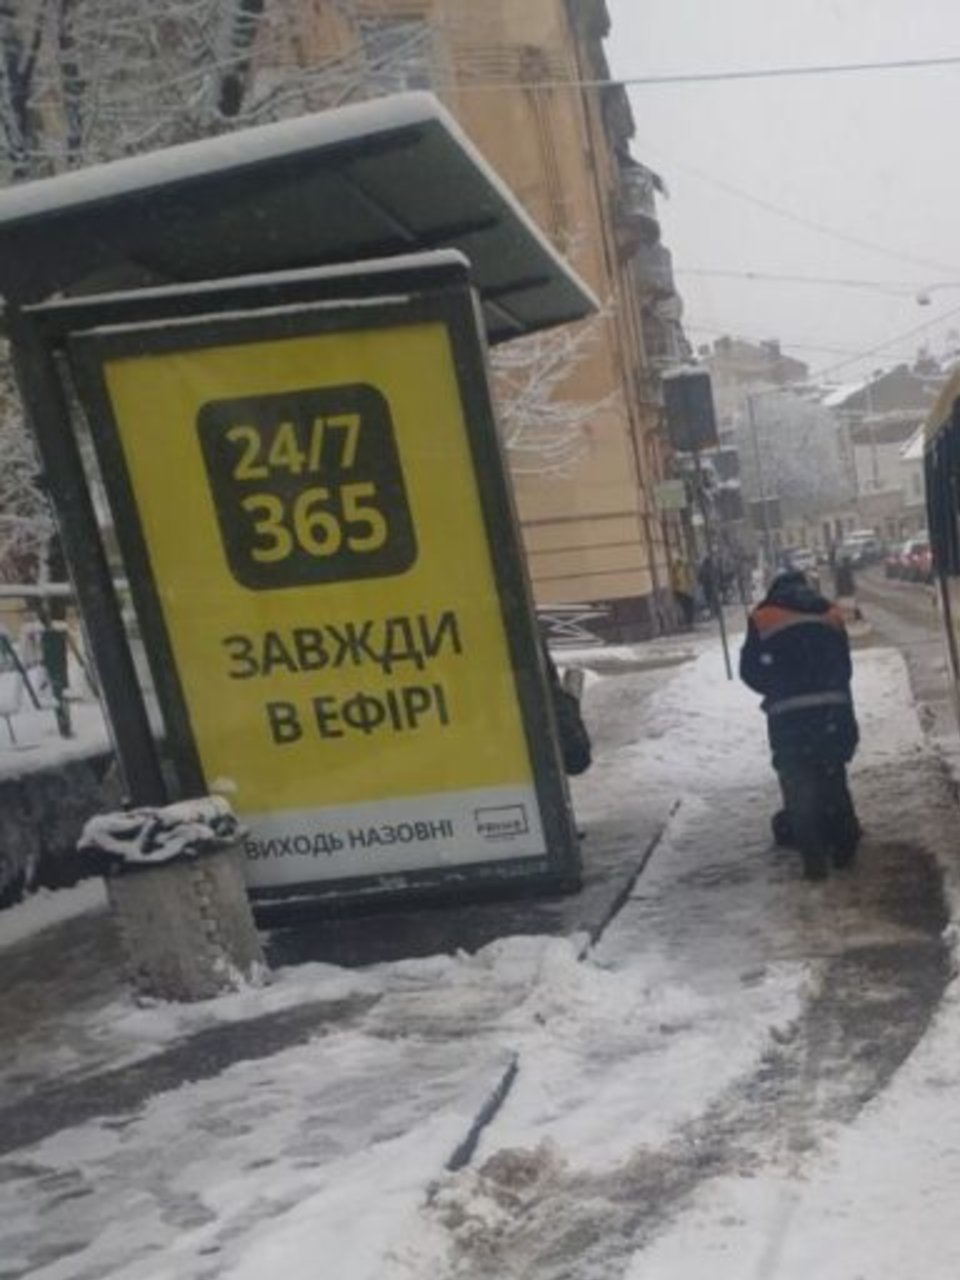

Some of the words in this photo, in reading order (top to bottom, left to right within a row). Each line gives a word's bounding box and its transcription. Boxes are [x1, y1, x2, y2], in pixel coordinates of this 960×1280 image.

[226, 413, 361, 481] 24/7
[240, 481, 388, 564] 365
[222, 610, 463, 679] ЗАВЖДИ
[266, 701, 304, 745] В
[312, 683, 449, 739] ЕФІРІ
[245, 832, 344, 861] ВИХОДЬ
[348, 820, 454, 849] НАЗОВНІ
